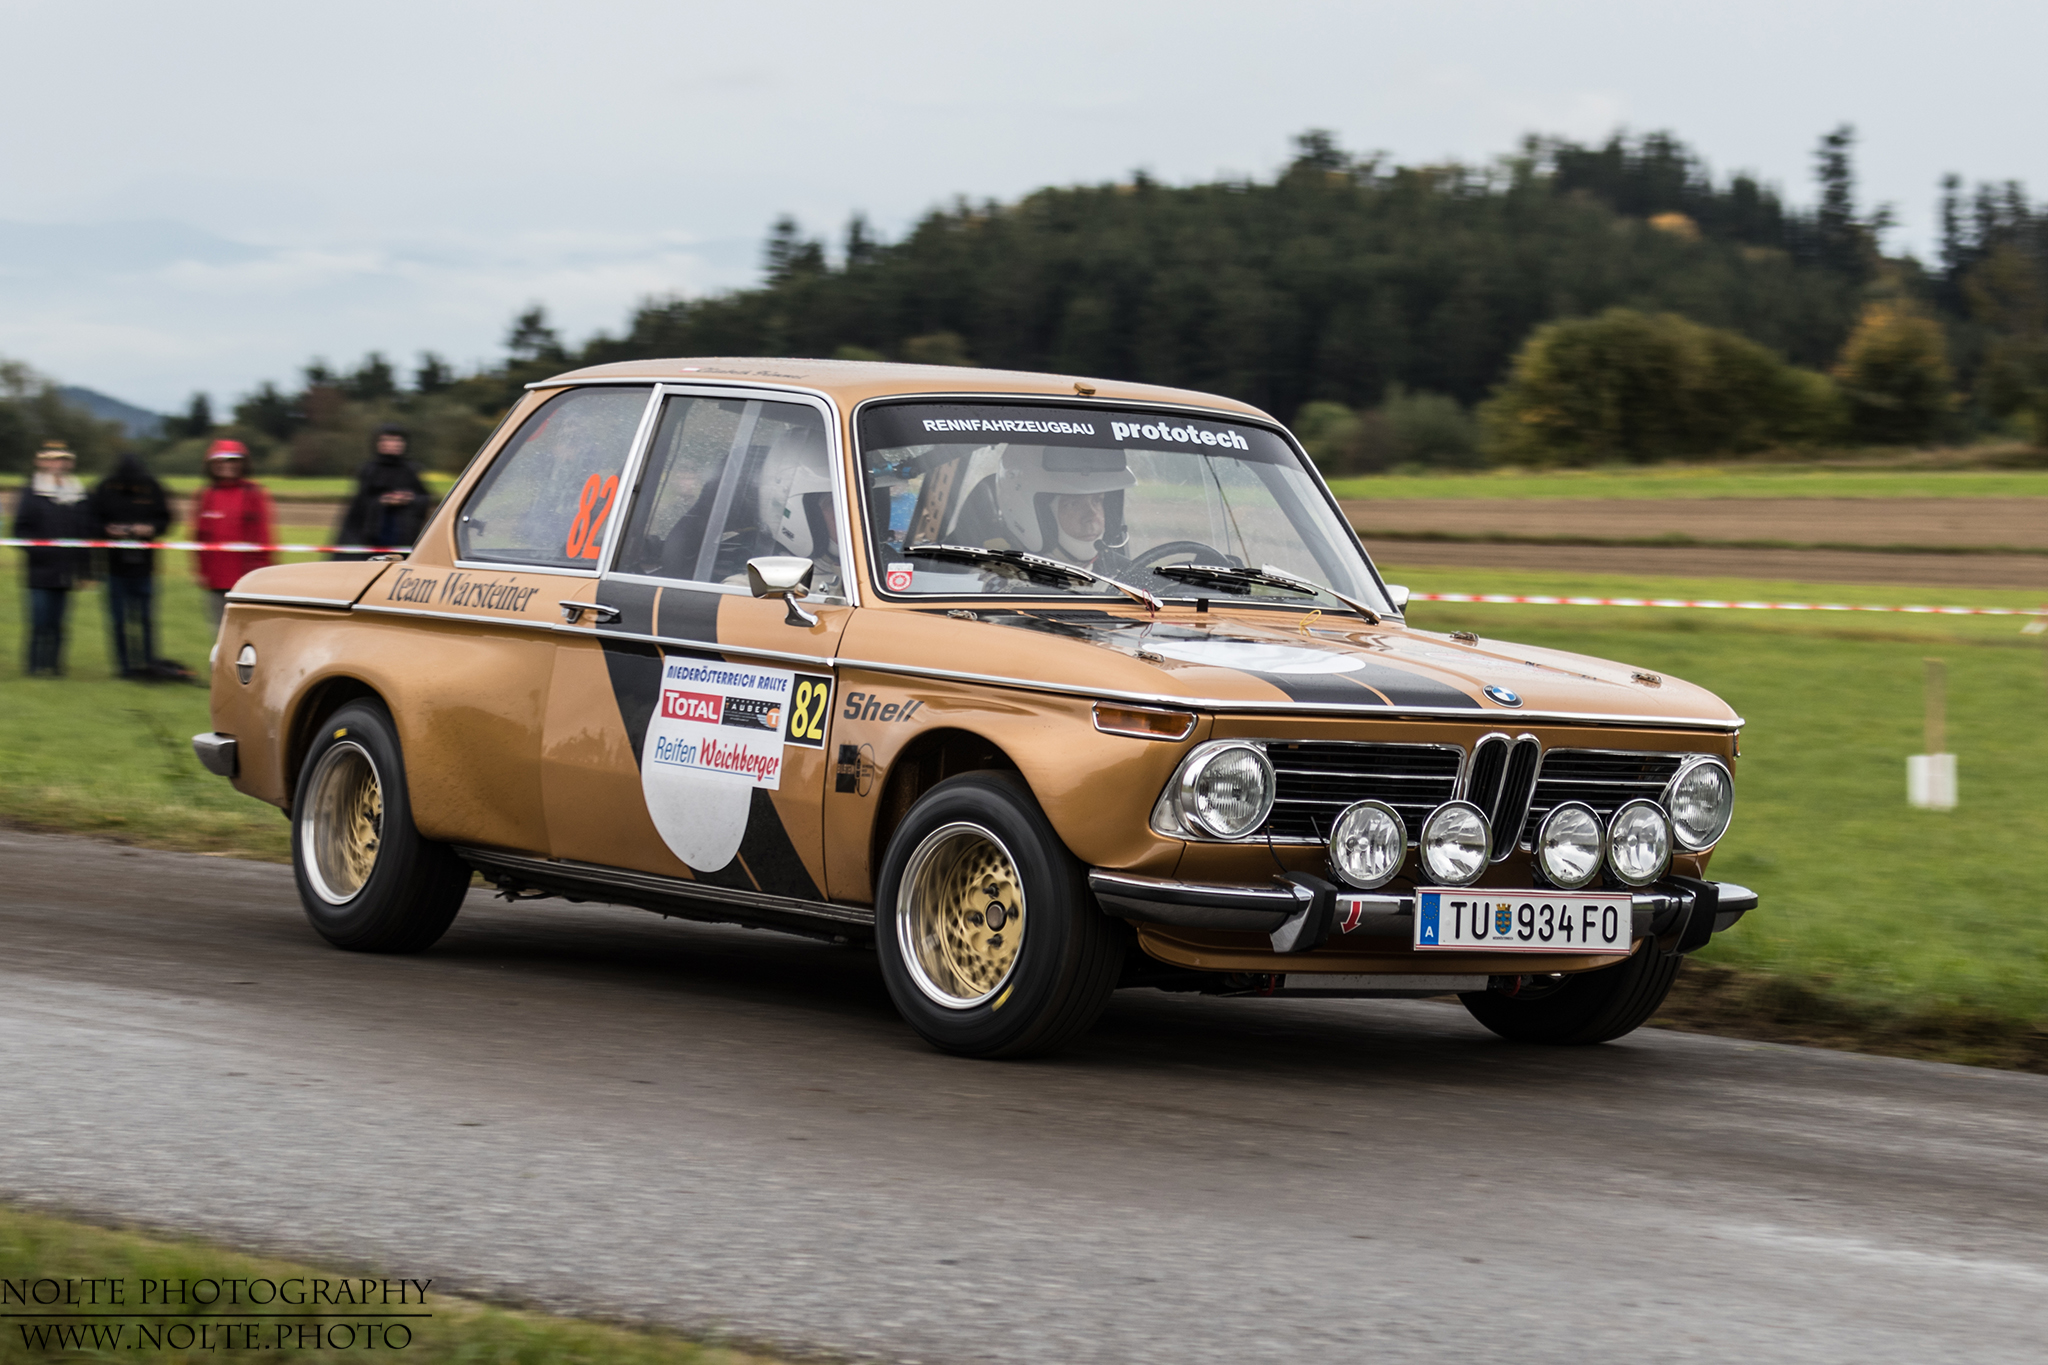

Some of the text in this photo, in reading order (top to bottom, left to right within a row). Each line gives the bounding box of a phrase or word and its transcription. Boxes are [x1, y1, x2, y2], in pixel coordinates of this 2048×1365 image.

[922, 419, 1249, 451] RENNFAHRZEUGBAU prototech
[566, 473, 619, 559] 82
[387, 568, 539, 612] Team Warsteiner
[666, 665, 788, 692] NIEDERÖSTERREICH RALLYE
[665, 692, 719, 720] TOTAL
[791, 681, 828, 740] 82
[843, 691, 925, 723] Shell
[655, 736, 780, 781] Reifen Weichberger
[1425, 926, 1434, 938] A
[1450, 901, 1489, 940] TU
[1517, 903, 1574, 943] 934
